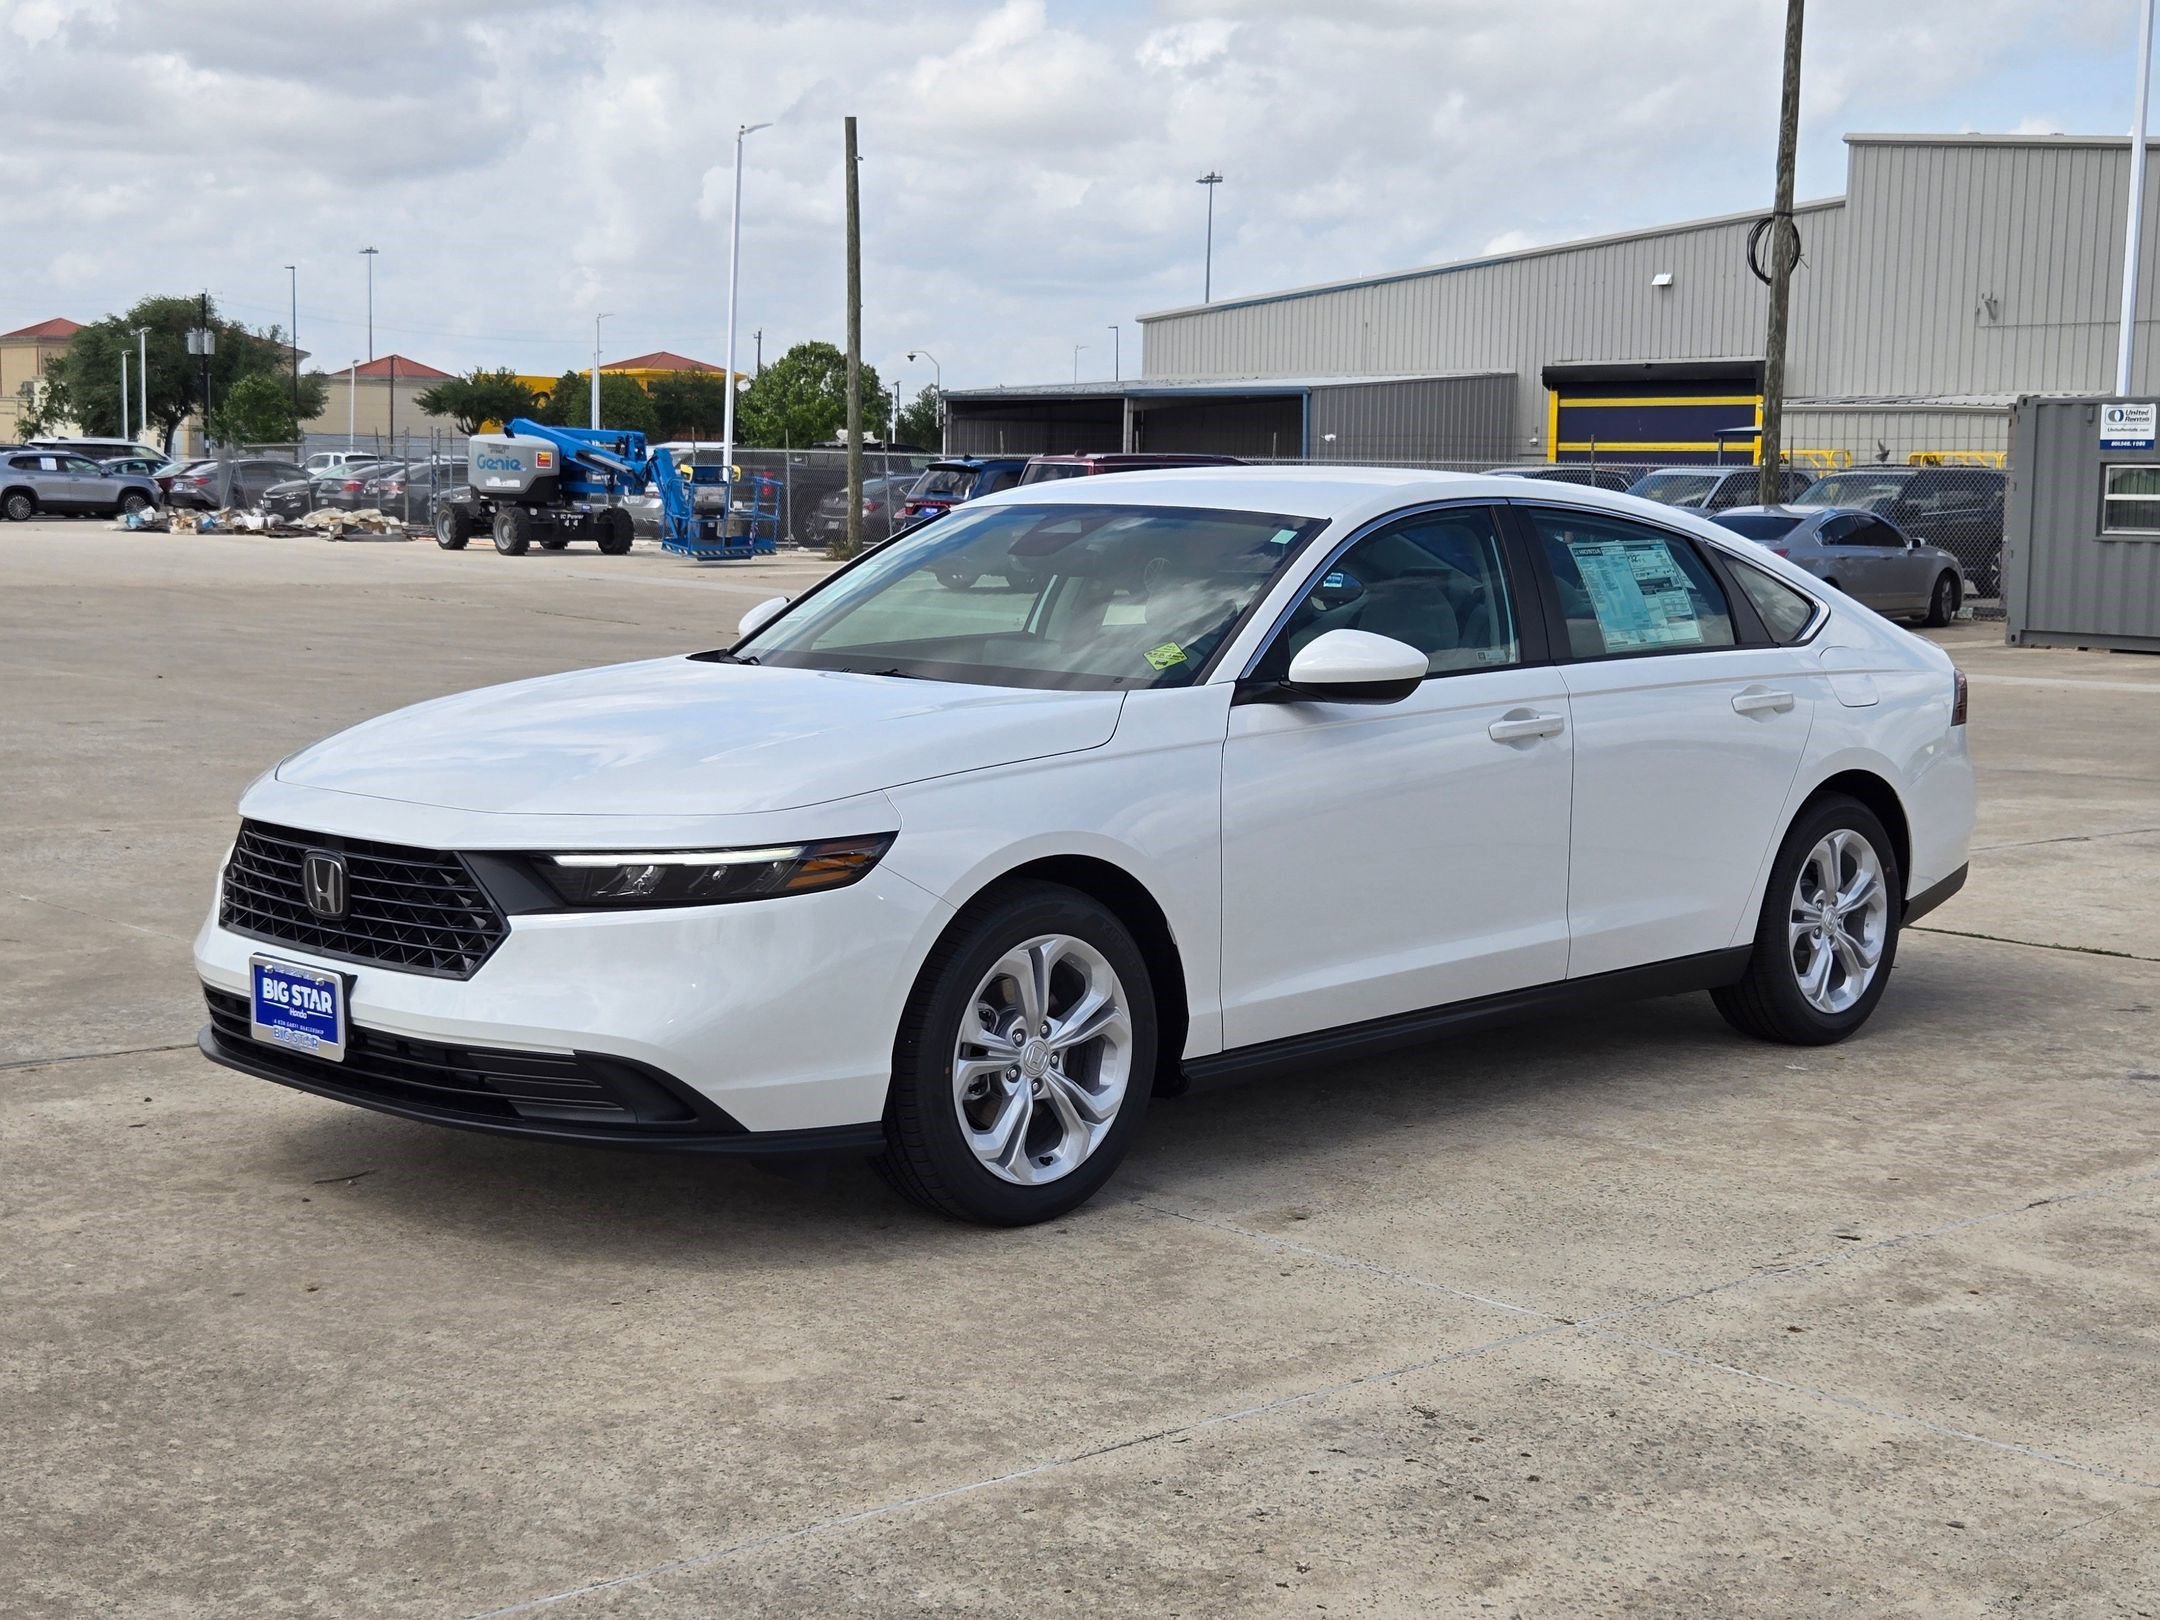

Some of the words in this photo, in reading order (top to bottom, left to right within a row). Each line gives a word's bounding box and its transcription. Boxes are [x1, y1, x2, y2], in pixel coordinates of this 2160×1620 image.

[477, 454, 521, 471] Genie
[263, 977, 289, 1003] BIG
[291, 984, 333, 1014] STAR
[290, 1007, 307, 1019] Honda
[273, 1027, 290, 1040] BIG
